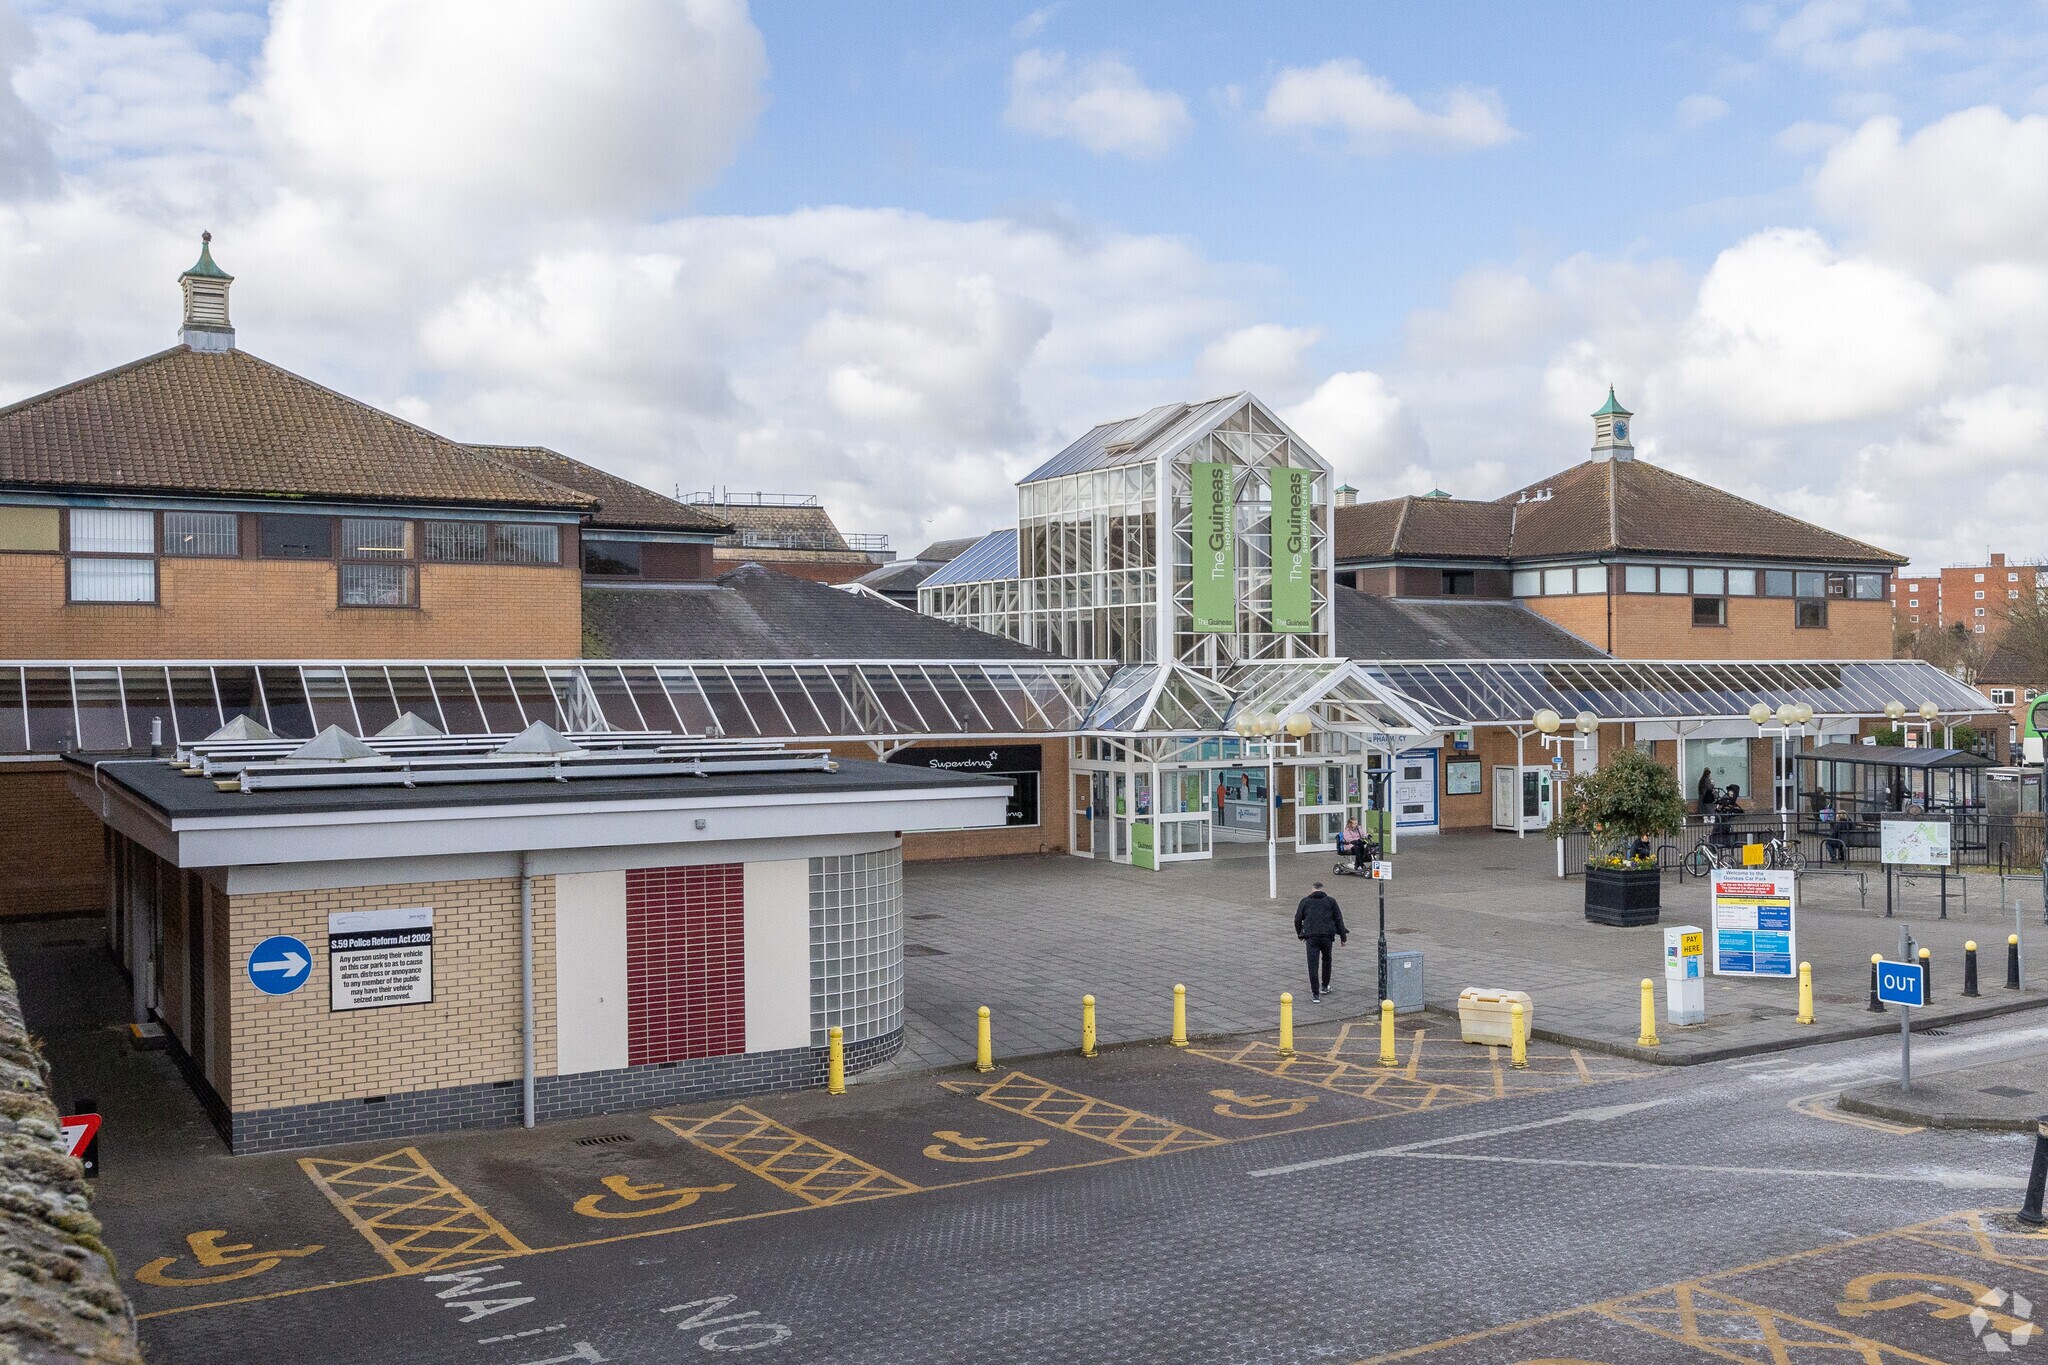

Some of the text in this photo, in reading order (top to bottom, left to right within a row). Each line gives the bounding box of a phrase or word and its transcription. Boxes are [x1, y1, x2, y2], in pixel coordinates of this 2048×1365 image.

[1208, 468, 1224, 552] Guineas
[1287, 472, 1302, 554] Guineas
[929, 759, 993, 770] Superdrug
[331, 934, 431, 948] S.59 Police Reform Act 2002
[371, 961, 383, 970] park
[360, 970, 384, 978] distress
[1884, 975, 1916, 992] OUT
[659, 1294, 792, 1352] NO
